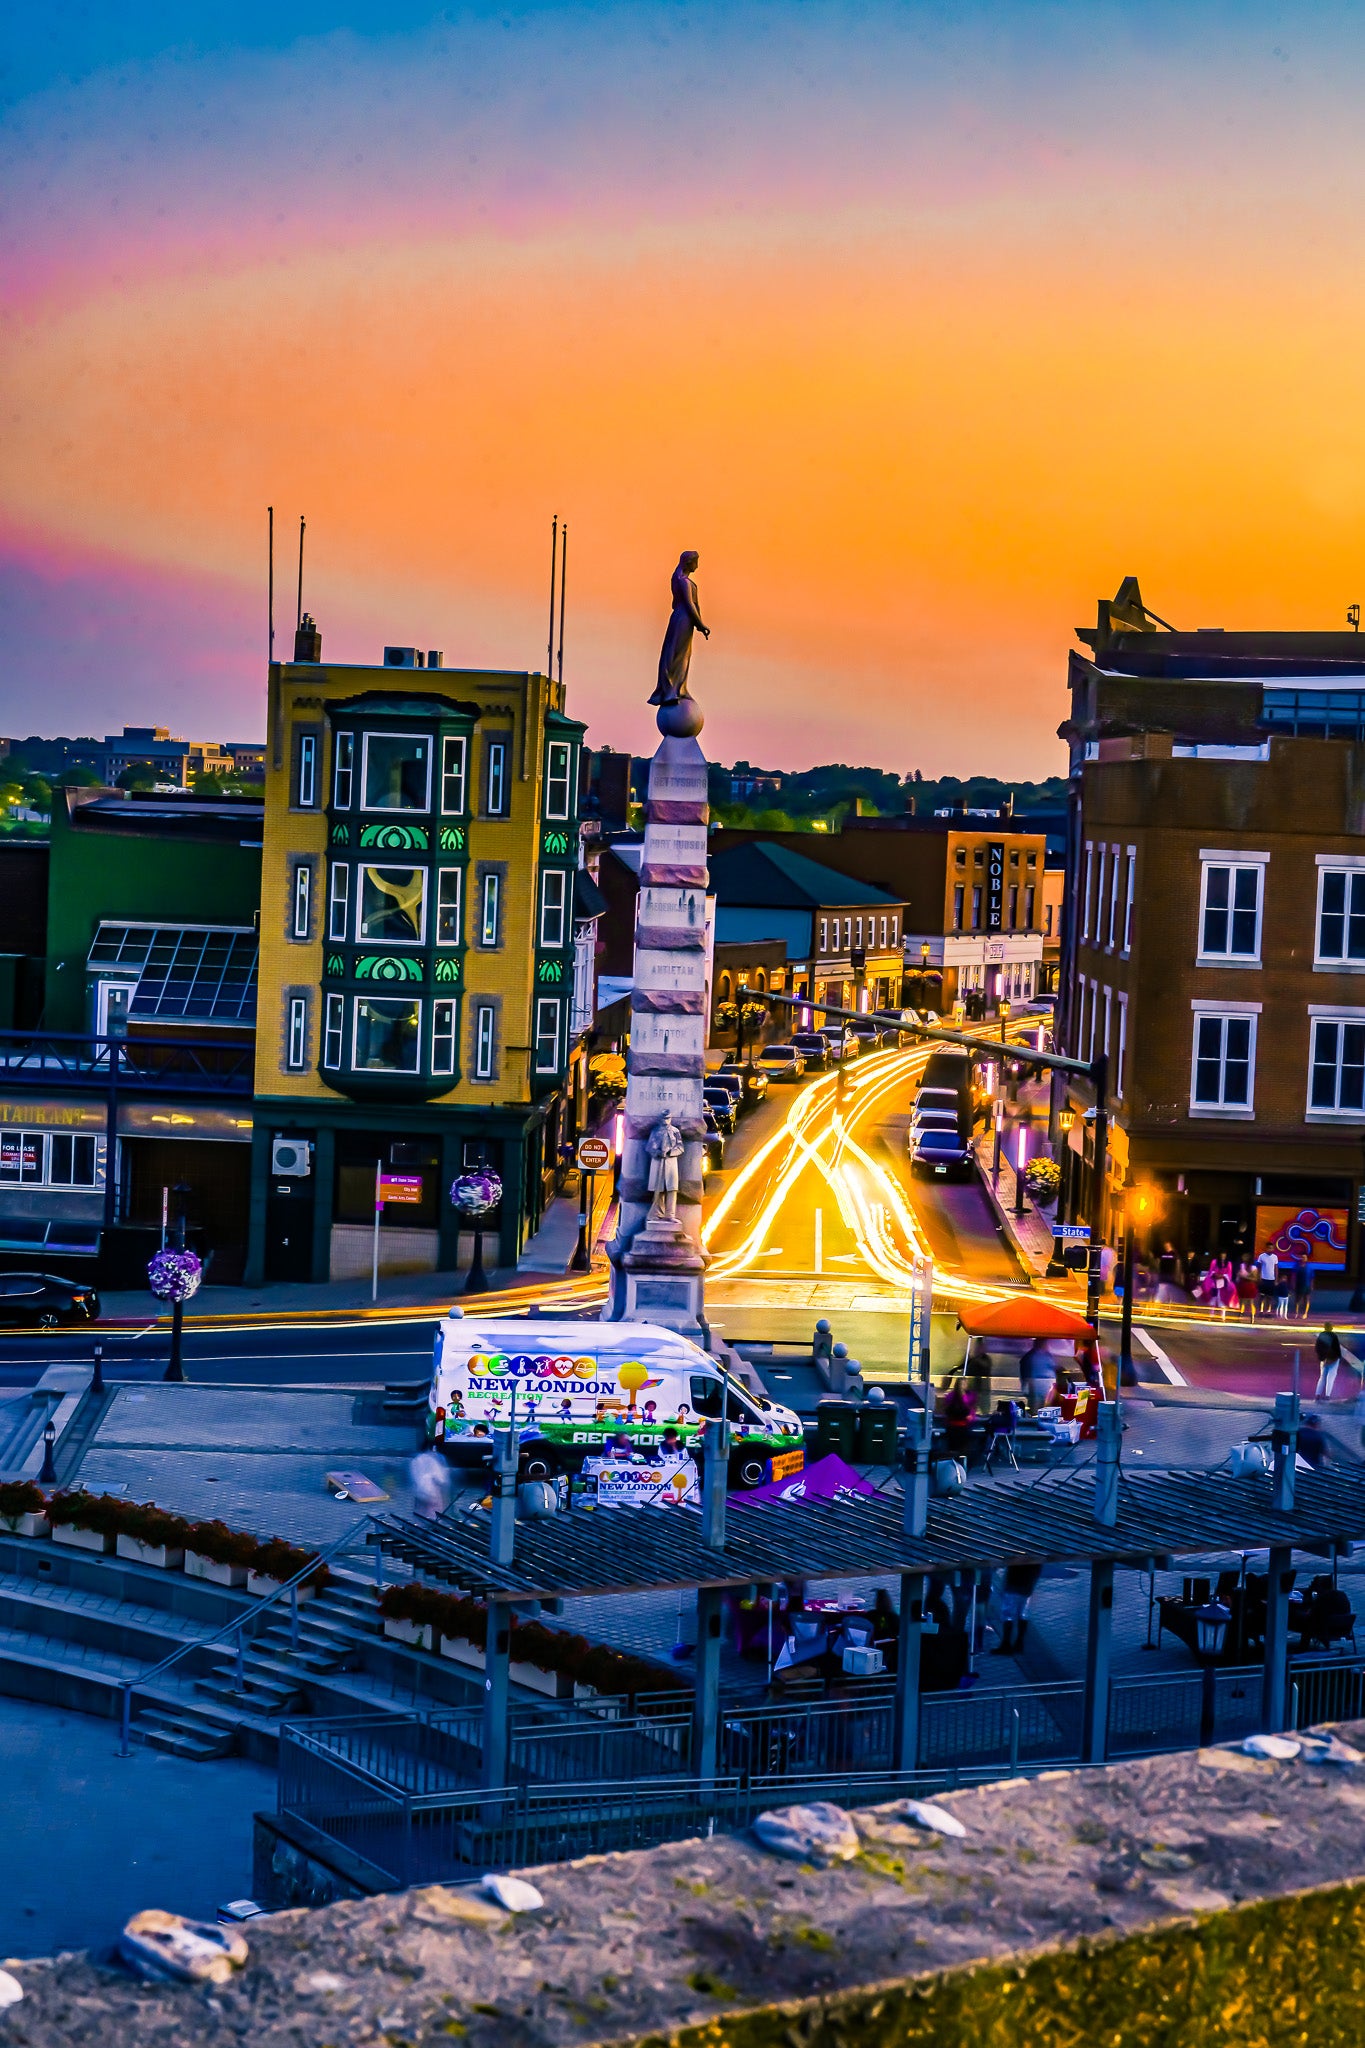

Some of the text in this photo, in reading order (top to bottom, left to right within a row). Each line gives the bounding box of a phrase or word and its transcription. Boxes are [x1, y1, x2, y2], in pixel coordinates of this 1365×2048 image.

[654, 777, 707, 788] GETTYSBURG
[650, 839, 706, 850] PORT HUDSON
[990, 848, 1002, 926] NOBLE
[651, 966, 694, 976] ANTIETAM
[653, 1028, 687, 1039] GROTON
[640, 1091, 696, 1102] BUNKER HILL
[1062, 1227, 1085, 1236] State
[467, 1378, 616, 1394] NEW LONDON
[599, 1483, 672, 1491] NEW LONDON
